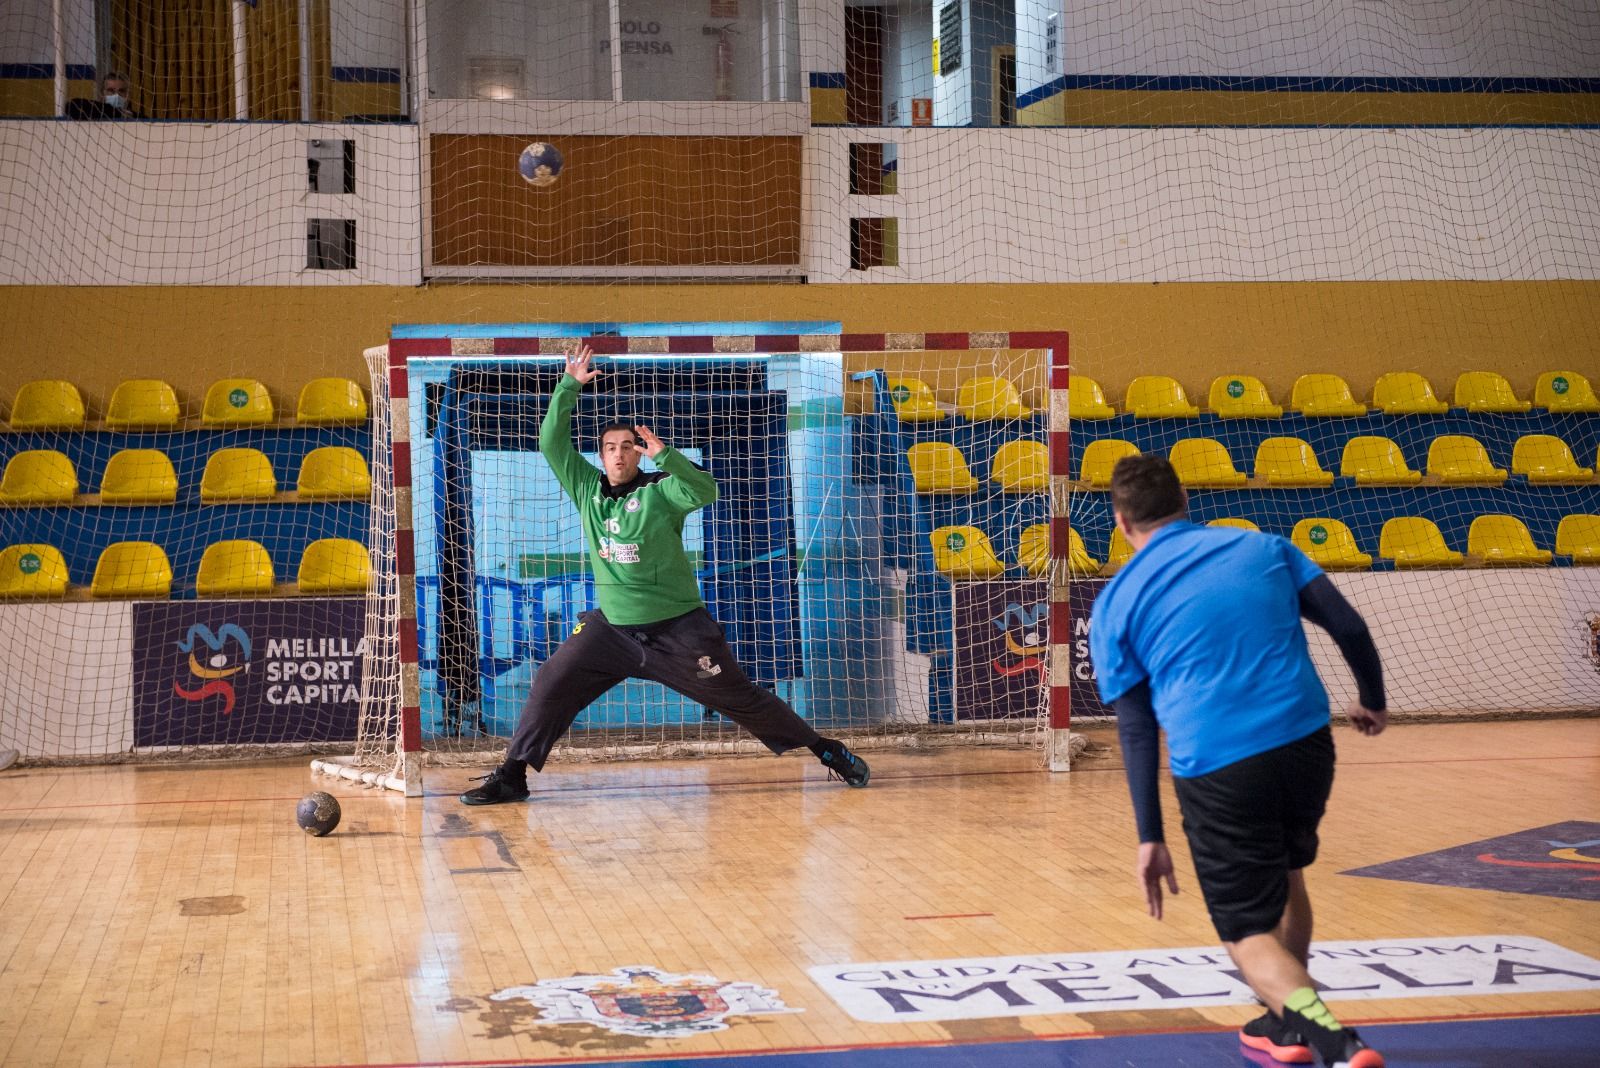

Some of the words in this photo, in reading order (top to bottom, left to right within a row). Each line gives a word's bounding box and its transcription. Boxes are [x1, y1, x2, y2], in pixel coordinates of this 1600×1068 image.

[619, 21, 661, 34] OLO
[600, 40, 674, 54] PENSA
[604, 517, 621, 535] 16
[267, 661, 354, 681] SPORT
[267, 684, 372, 705] CAPITA
[835, 961, 1096, 981] CIUDAD
[1127, 944, 1541, 968] AUNOMA
